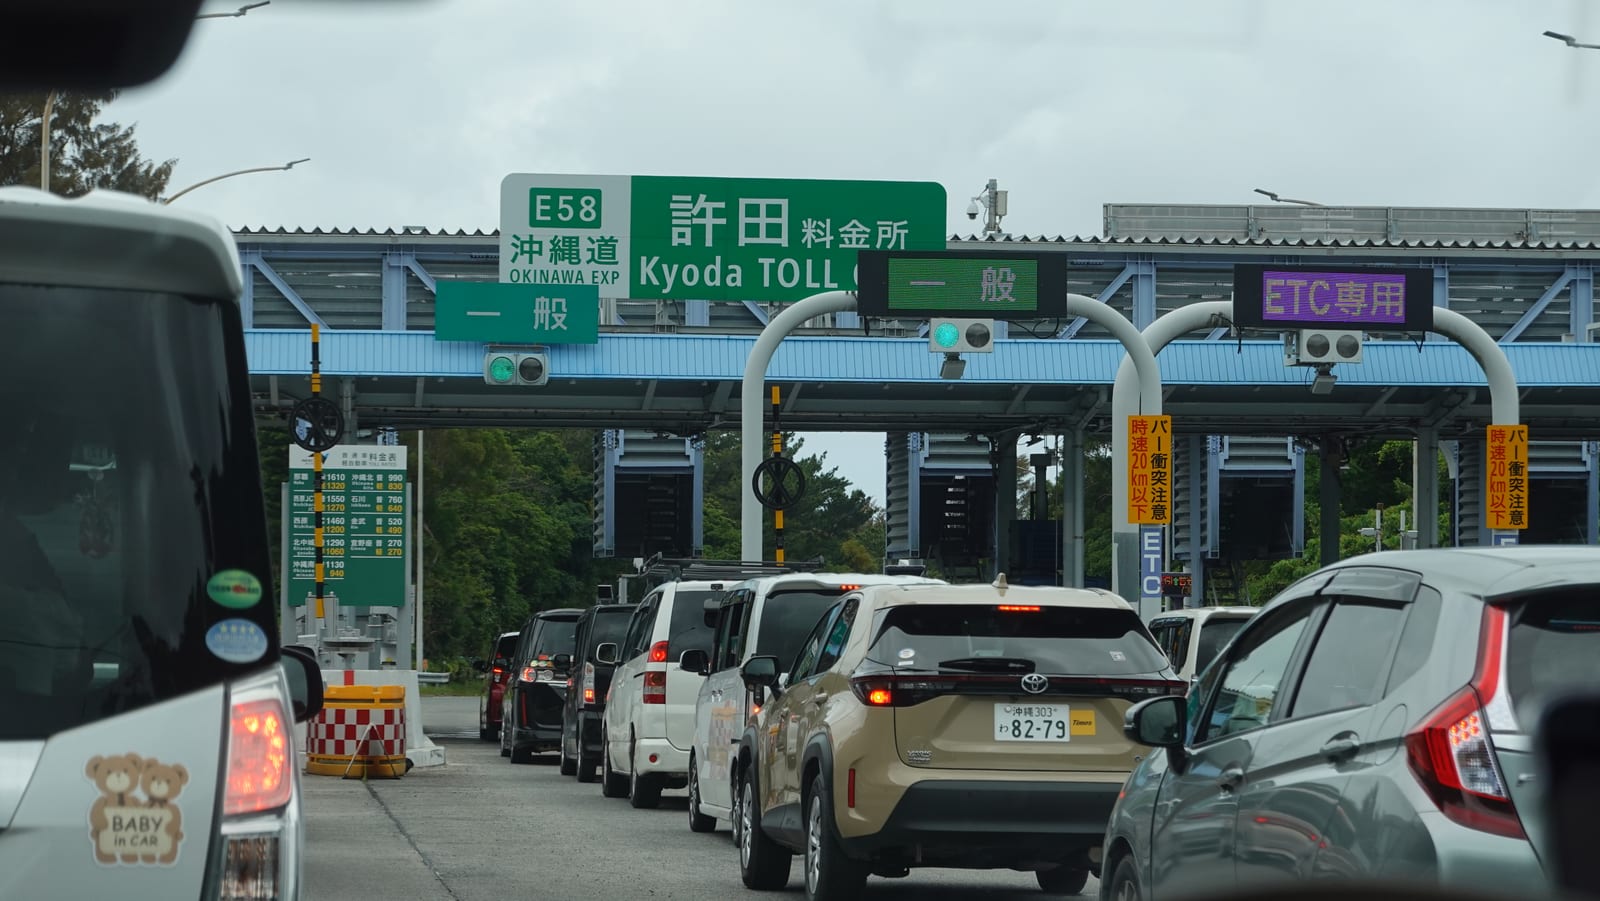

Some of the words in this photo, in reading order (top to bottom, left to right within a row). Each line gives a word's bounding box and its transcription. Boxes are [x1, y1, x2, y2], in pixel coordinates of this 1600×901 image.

[535, 194, 597, 223] E58
[669, 193, 790, 248] 許田
[801, 218, 909, 250] 料金所
[510, 234, 620, 265] 沖縄道
[510, 269, 585, 284] OKINAWA
[592, 270, 620, 285] EXP
[640, 255, 742, 294] Kyoda
[758, 258, 838, 289] TOLL
[909, 266, 1016, 303] 一般
[466, 296, 568, 331] 一般
[1264, 278, 1406, 319] ETC専用
[1150, 419, 1168, 521] バー衝突注意
[1509, 429, 1525, 526] バー衝突注意
[1143, 531, 1161, 595] ETC
[999, 724, 1009, 733] わ
[1011, 719, 1066, 739] 82-79
[112, 815, 163, 833] BABY
[114, 835, 126, 847] in
[129, 835, 159, 847] CAR
